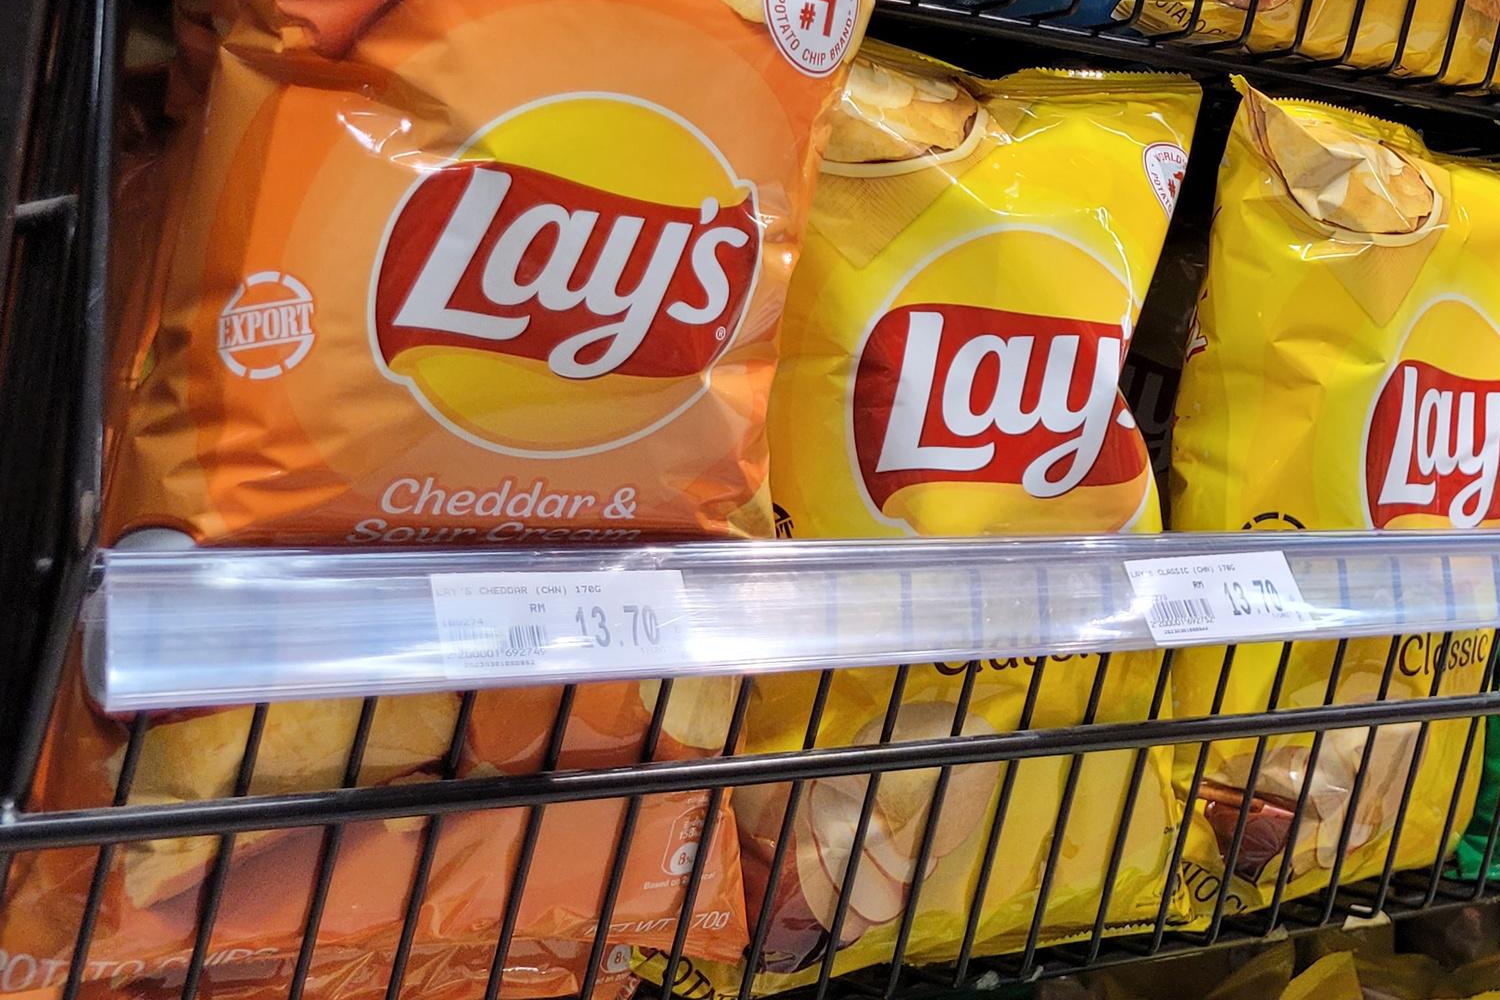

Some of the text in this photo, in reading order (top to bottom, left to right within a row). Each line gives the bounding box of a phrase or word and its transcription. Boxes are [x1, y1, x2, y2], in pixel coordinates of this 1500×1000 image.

[802, 48, 827, 66] CHIP
[829, 18, 853, 61] BRAND
[393, 168, 749, 379] Lay's
[218, 300, 314, 353] EXPORT
[381, 477, 638, 520] Cheddar &
[346, 518, 476, 544] Sour
[479, 585, 528, 596] CHEDDAR
[535, 584, 568, 597] (CHN)
[1223, 578, 1284, 616] 13.70
[529, 602, 660, 649] RM 13.70
[690, 910, 731, 931] 70g
